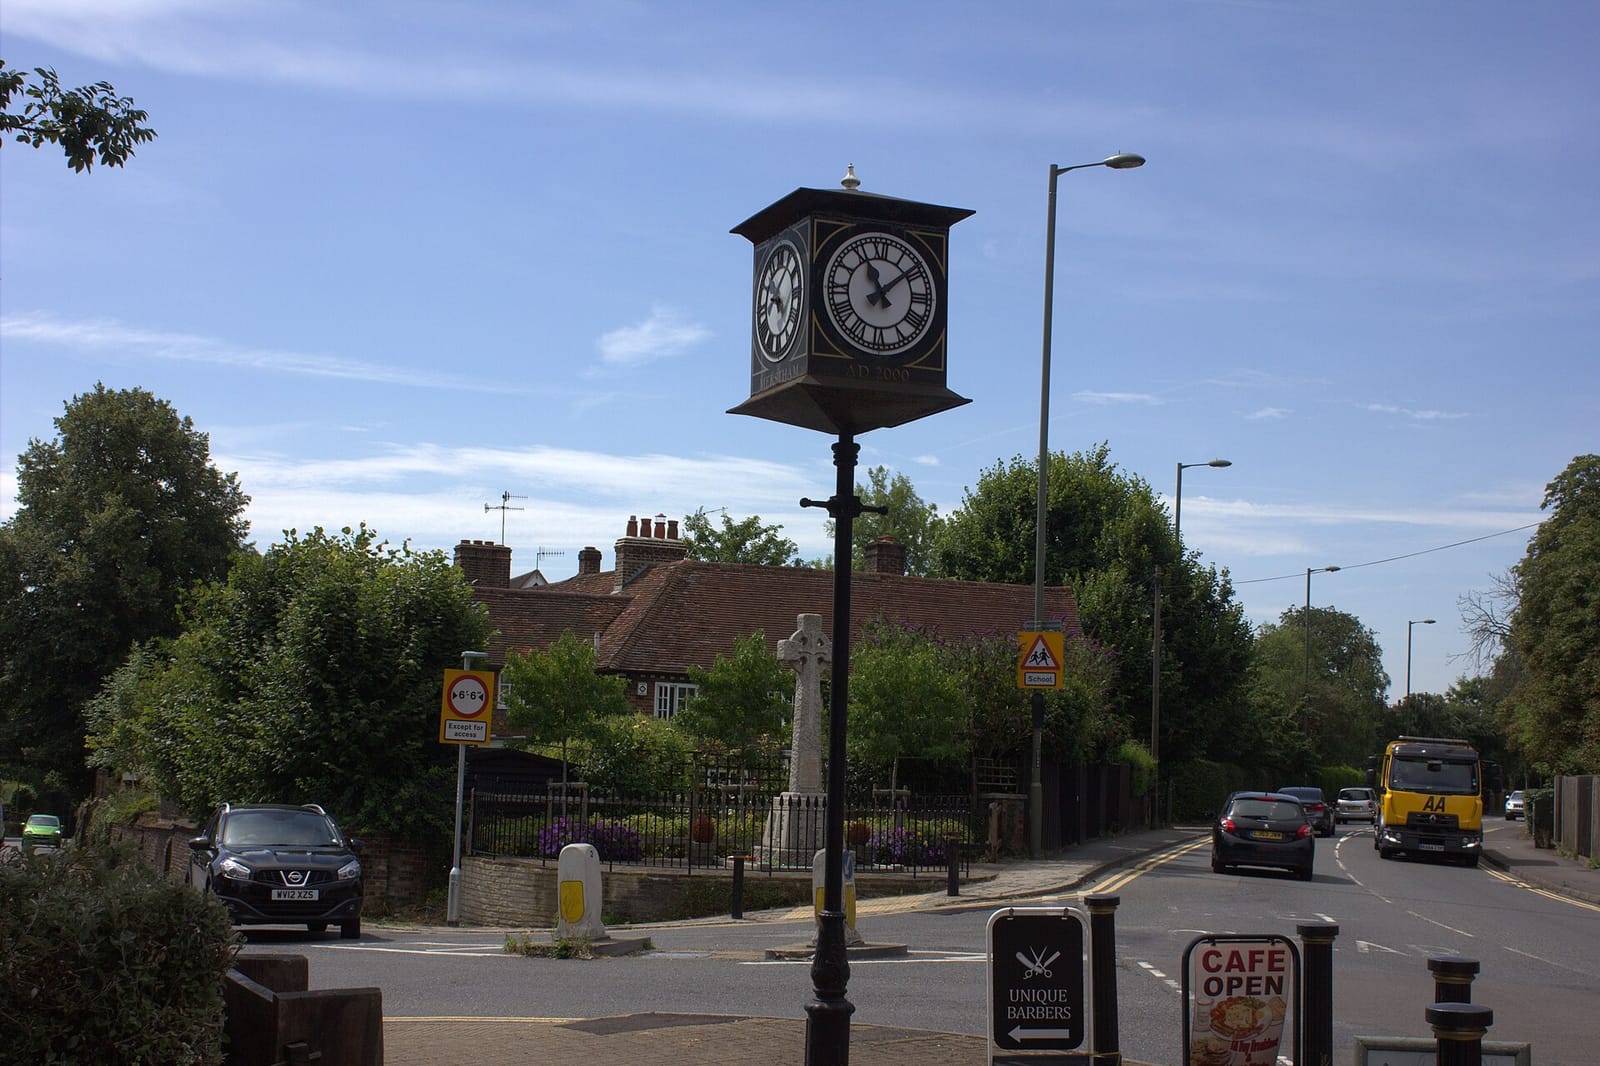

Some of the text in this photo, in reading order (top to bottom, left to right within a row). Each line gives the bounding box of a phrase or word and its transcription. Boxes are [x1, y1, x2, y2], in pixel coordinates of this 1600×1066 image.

[847, 364, 911, 382] AD 2000
[1027, 675, 1053, 683] School
[448, 722, 472, 731] Except
[1422, 796, 1446, 812] AA
[1202, 949, 1286, 973] CAFE
[1203, 976, 1284, 997] OPEN
[1009, 988, 1068, 1005] UNIQUE
[1007, 1006, 1072, 1020] BARBERS
